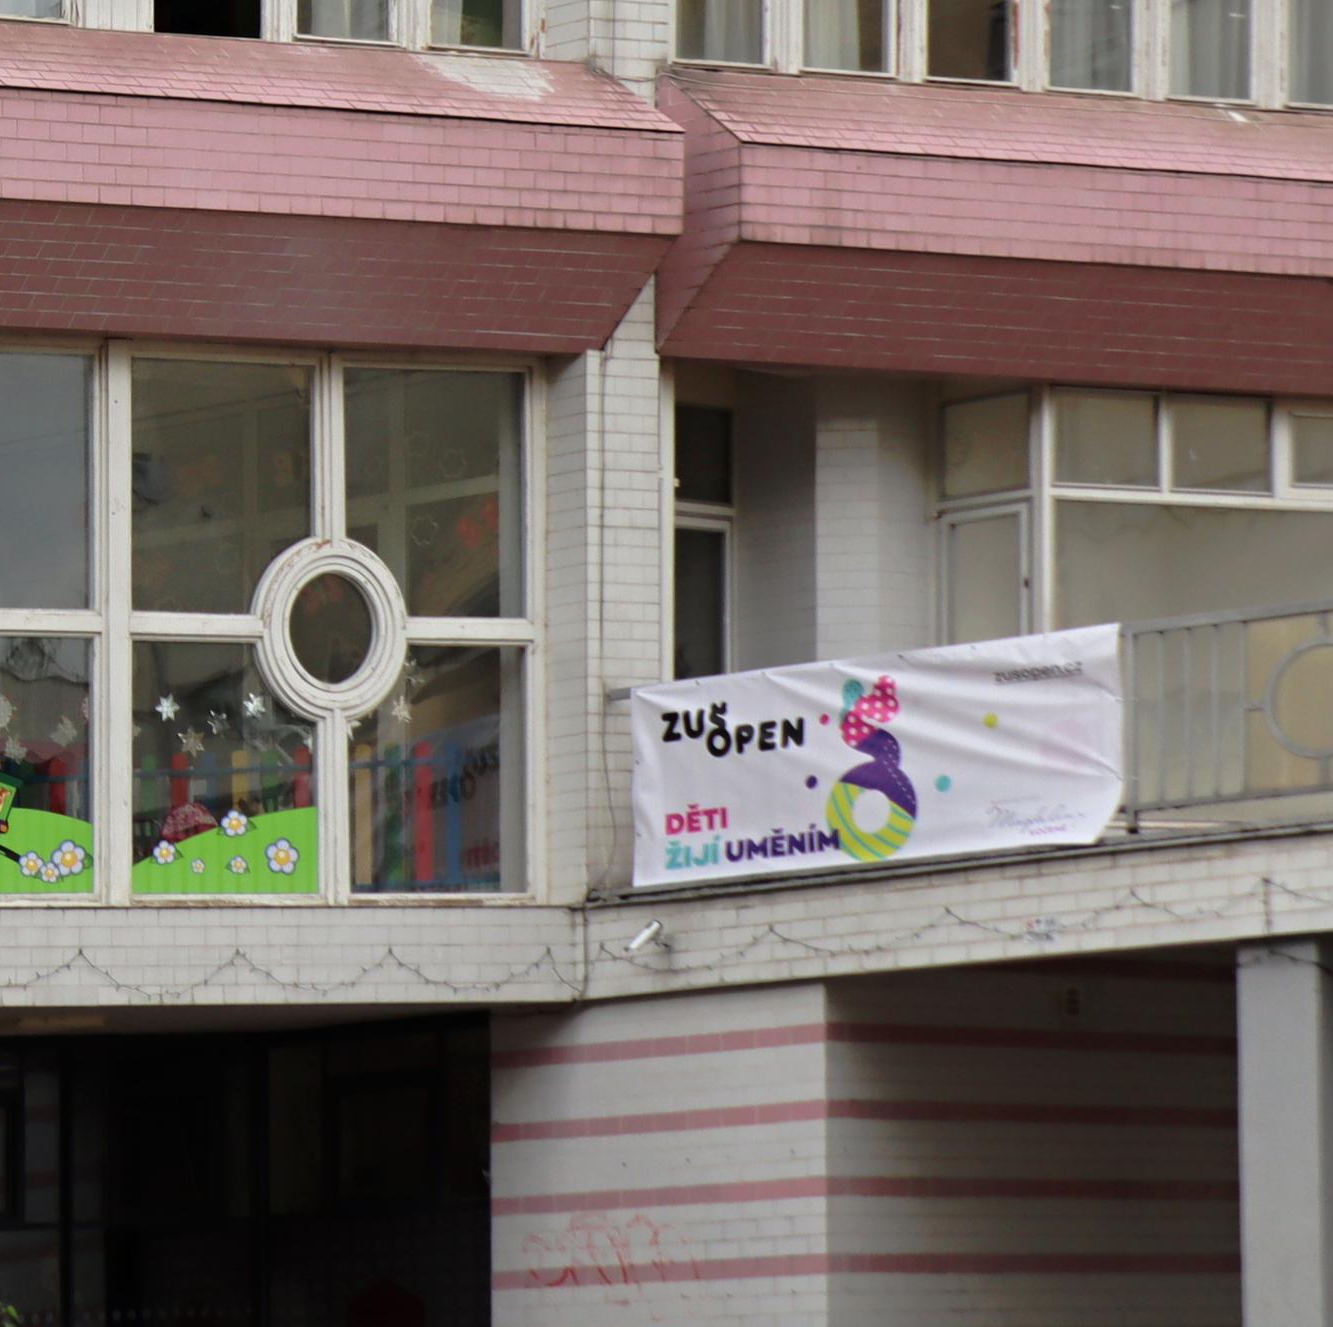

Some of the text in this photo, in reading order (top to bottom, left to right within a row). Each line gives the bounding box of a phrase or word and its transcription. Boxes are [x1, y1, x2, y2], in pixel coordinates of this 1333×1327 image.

[661, 701, 727, 743] ZUŠ
[706, 716, 805, 757] OPEN
[665, 803, 729, 835] DĚTI
[665, 823, 841, 870] ŽIJÍ UMĚNÍM
